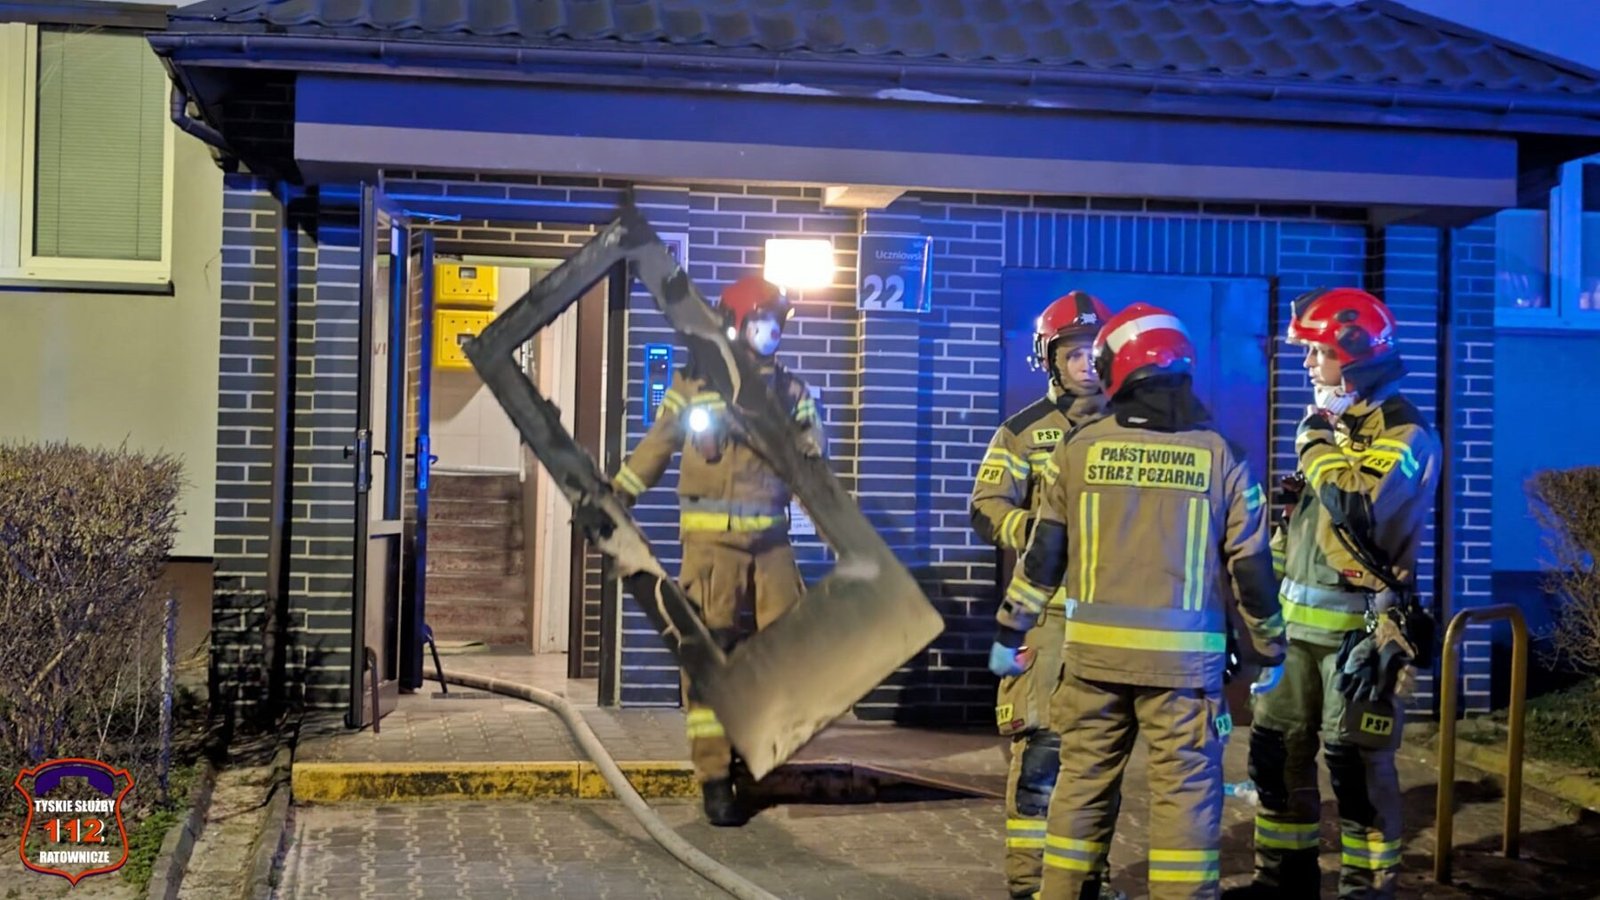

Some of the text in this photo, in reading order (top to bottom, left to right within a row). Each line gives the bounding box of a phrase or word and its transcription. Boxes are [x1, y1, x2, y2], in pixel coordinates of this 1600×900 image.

[863, 274, 904, 309] 22
[1037, 430, 1060, 440] PSP
[1100, 445, 1195, 467] PAŃSTWOWA
[981, 469, 999, 480] PSP
[1365, 717, 1390, 731] PSP
